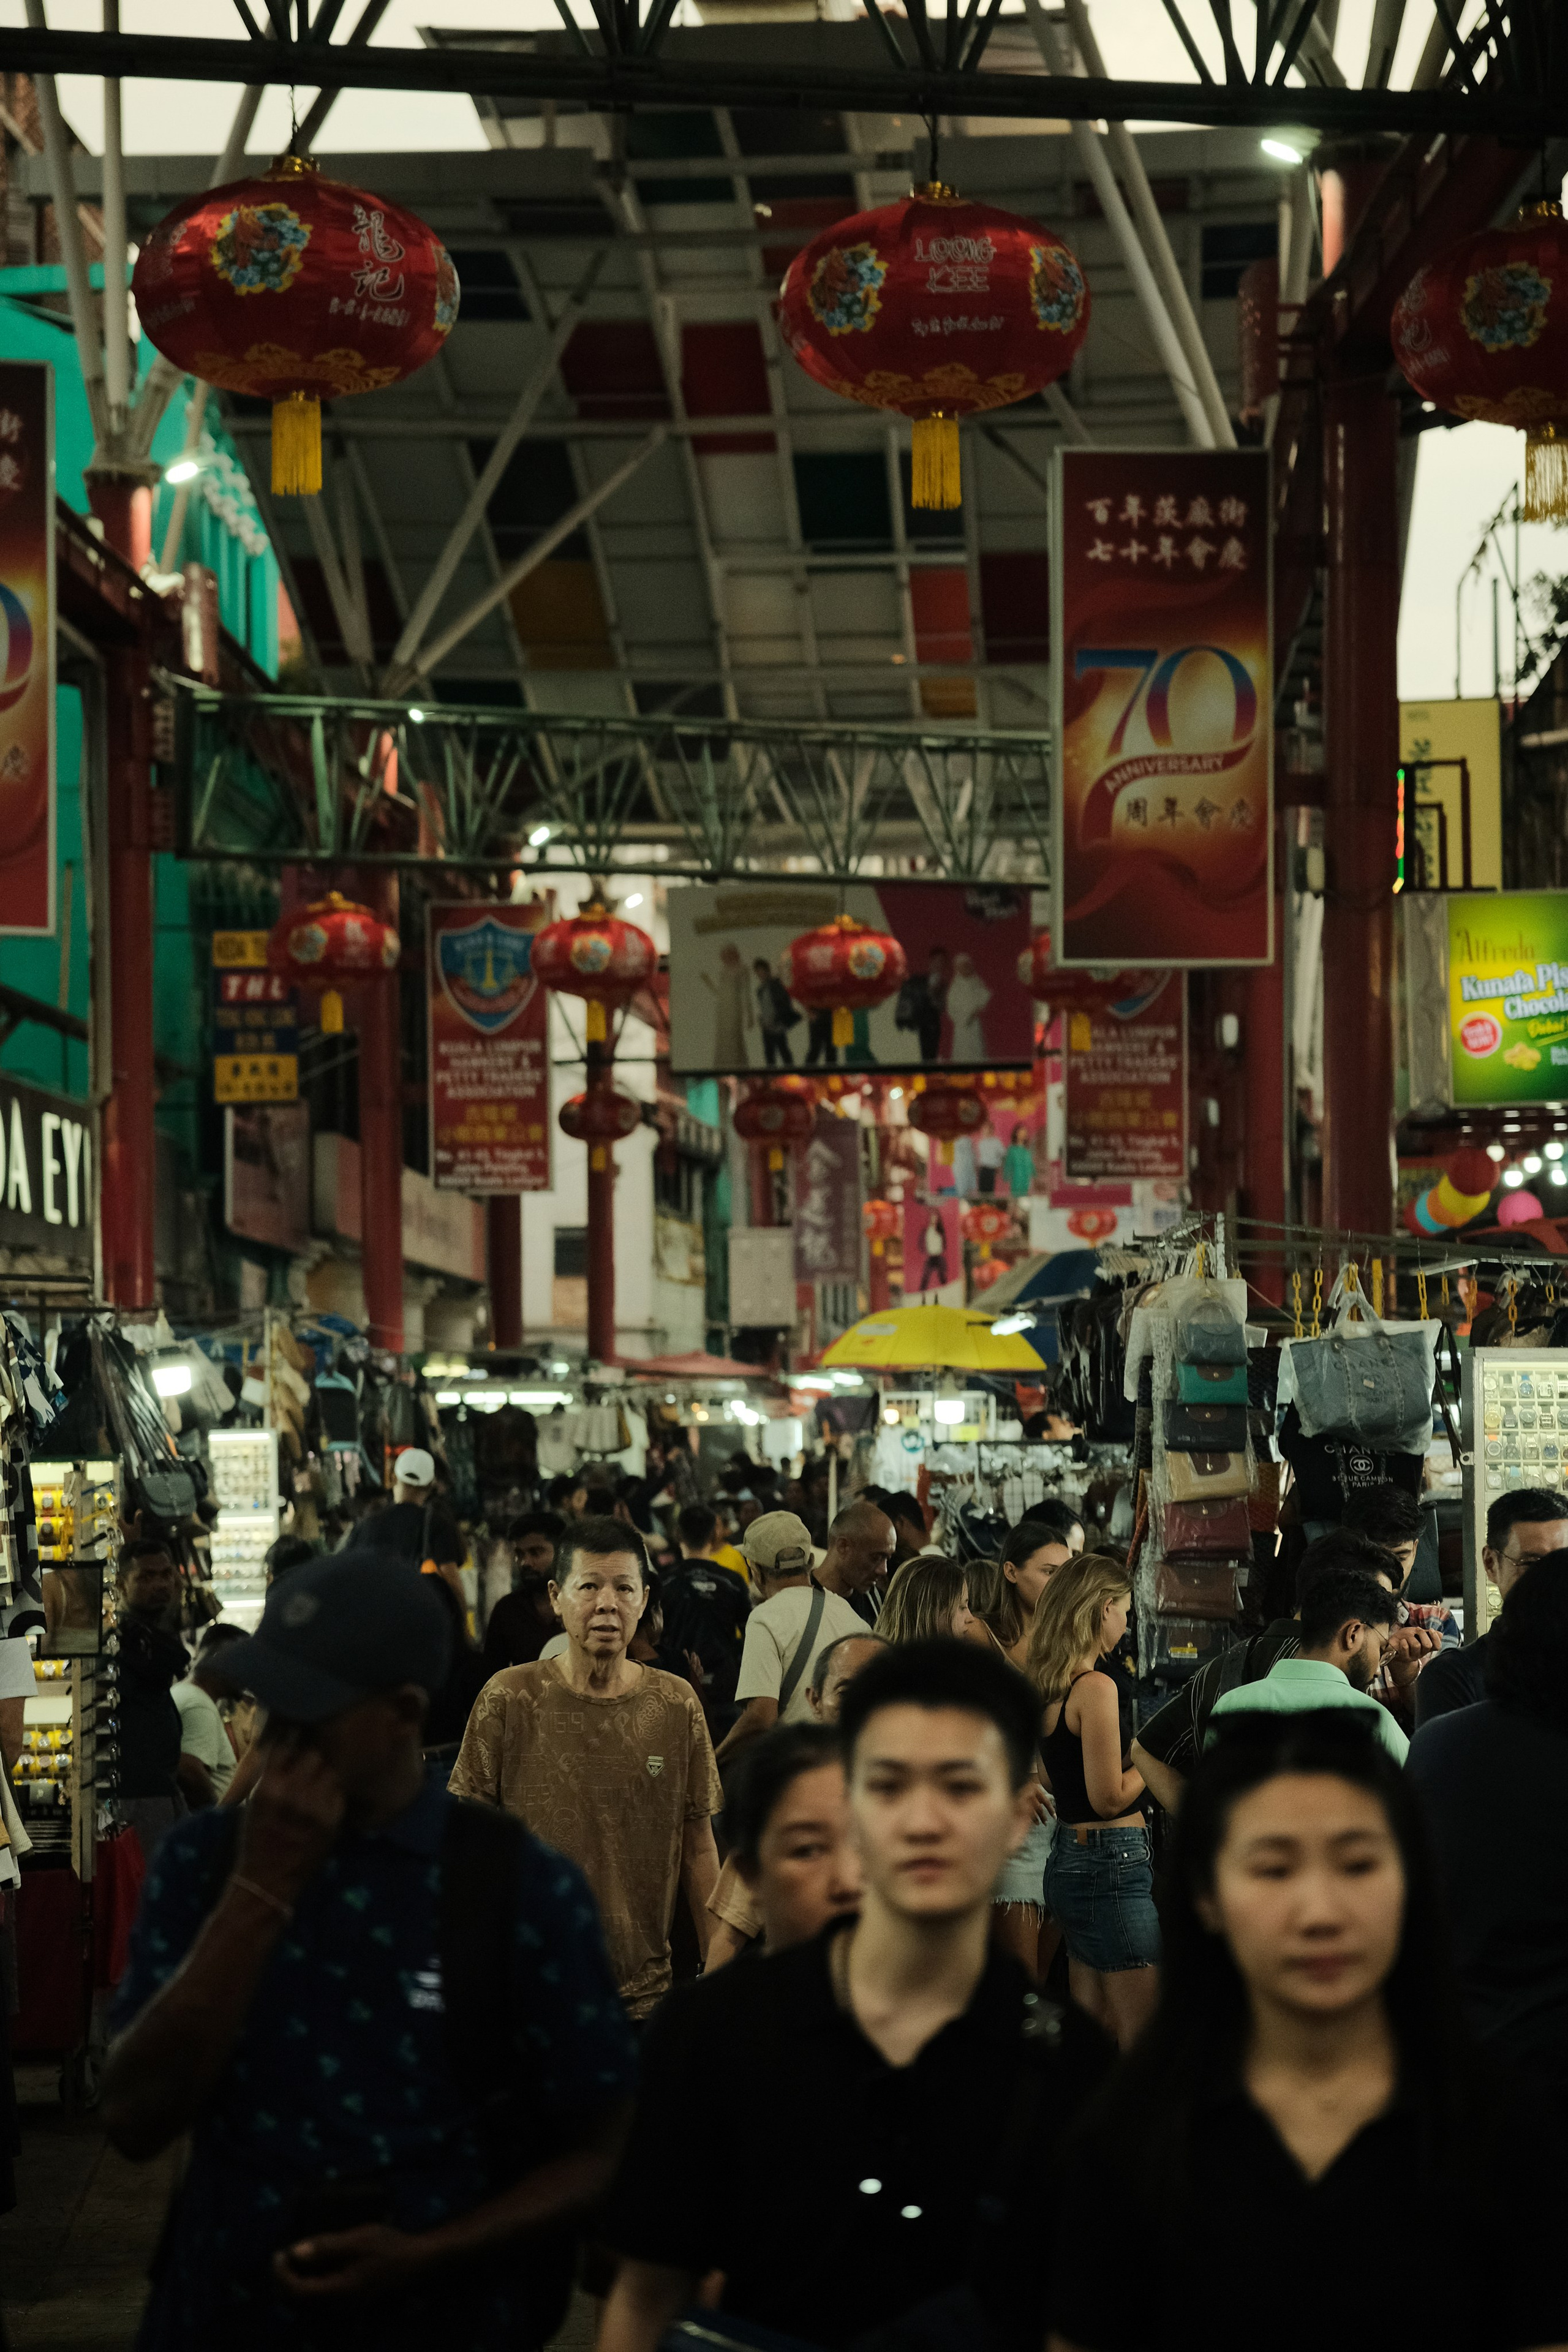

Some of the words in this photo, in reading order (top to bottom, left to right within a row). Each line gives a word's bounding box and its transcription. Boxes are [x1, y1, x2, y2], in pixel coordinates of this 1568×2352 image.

[925, 265, 990, 294] KEE
[1075, 645, 1257, 758] 70
[1104, 753, 1225, 795] ANNIVERSARY
[1460, 969, 1536, 1001] Kunafa
[0, 1096, 31, 1214] A
